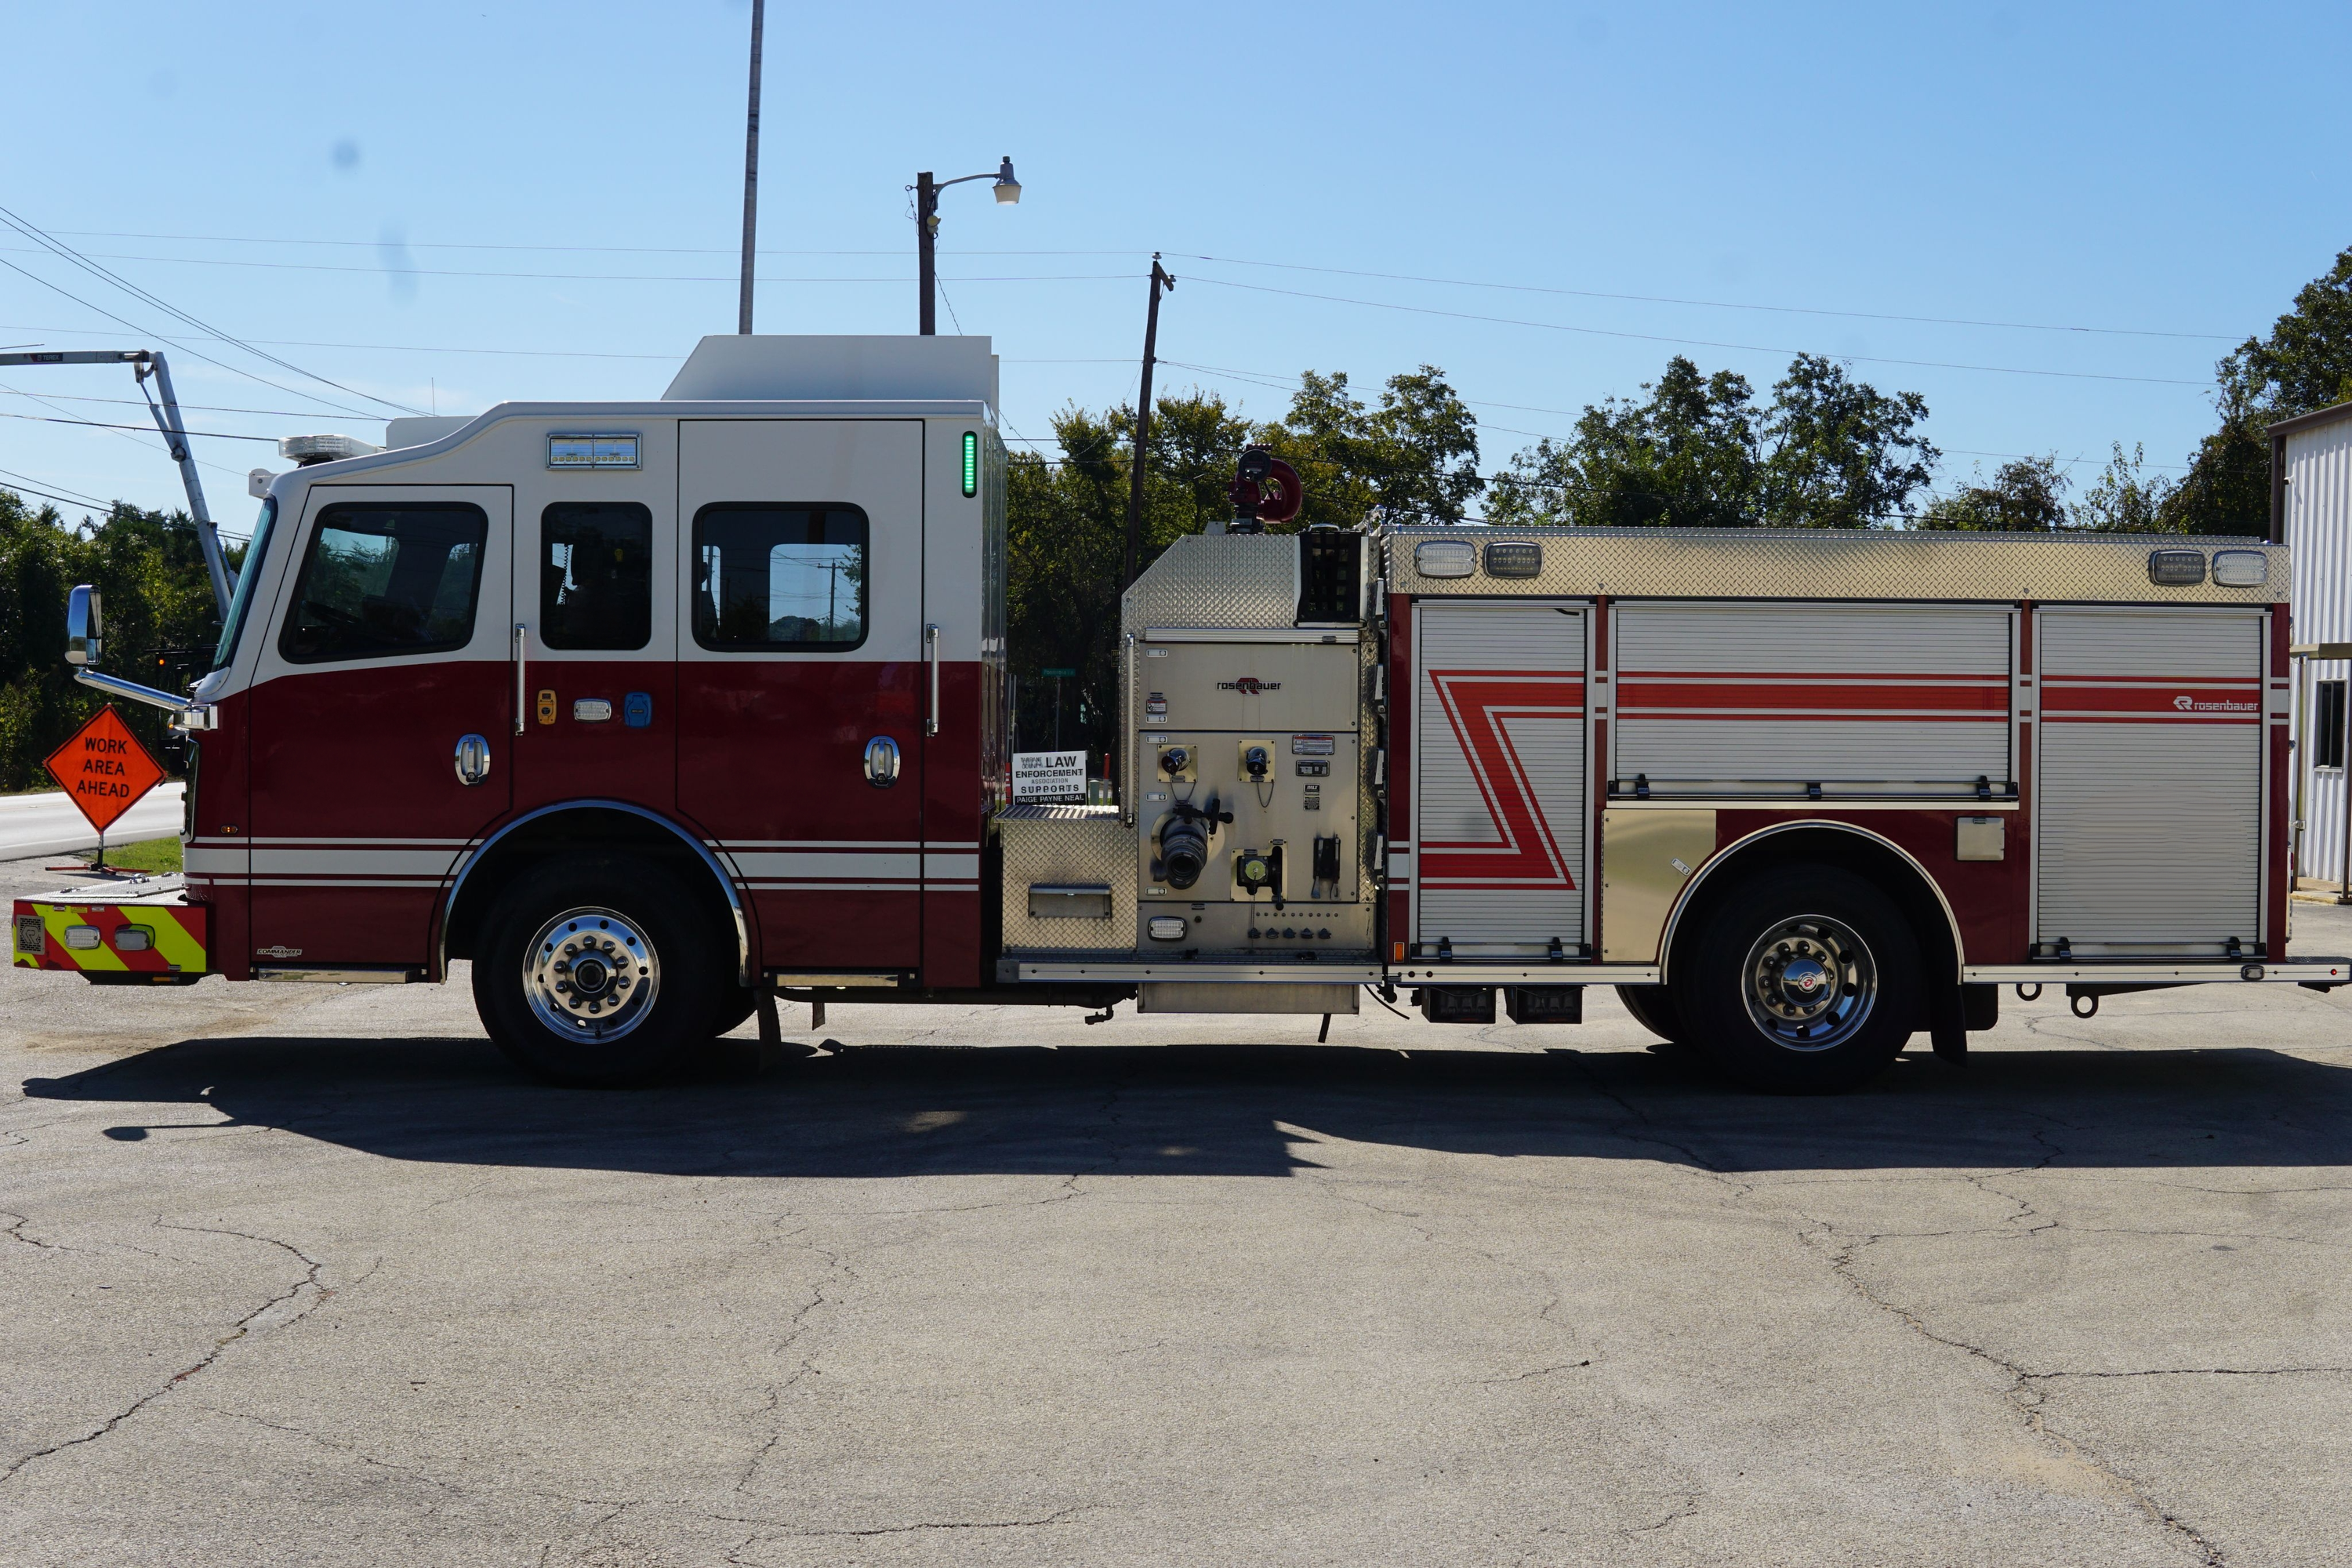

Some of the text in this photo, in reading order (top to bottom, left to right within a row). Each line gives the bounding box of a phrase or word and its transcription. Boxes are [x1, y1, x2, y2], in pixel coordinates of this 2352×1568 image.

[1217, 680, 1282, 690] rosenbauer
[2194, 699, 2258, 710] rosenbauer
[85, 737, 128, 754] WORK
[83, 759, 125, 776] AREA
[1045, 756, 1077, 768] LAW
[1015, 768, 1083, 779] ENFORCEMENT
[76, 779, 129, 797] AHEAD
[1021, 784, 1080, 793] SUPPORTS
